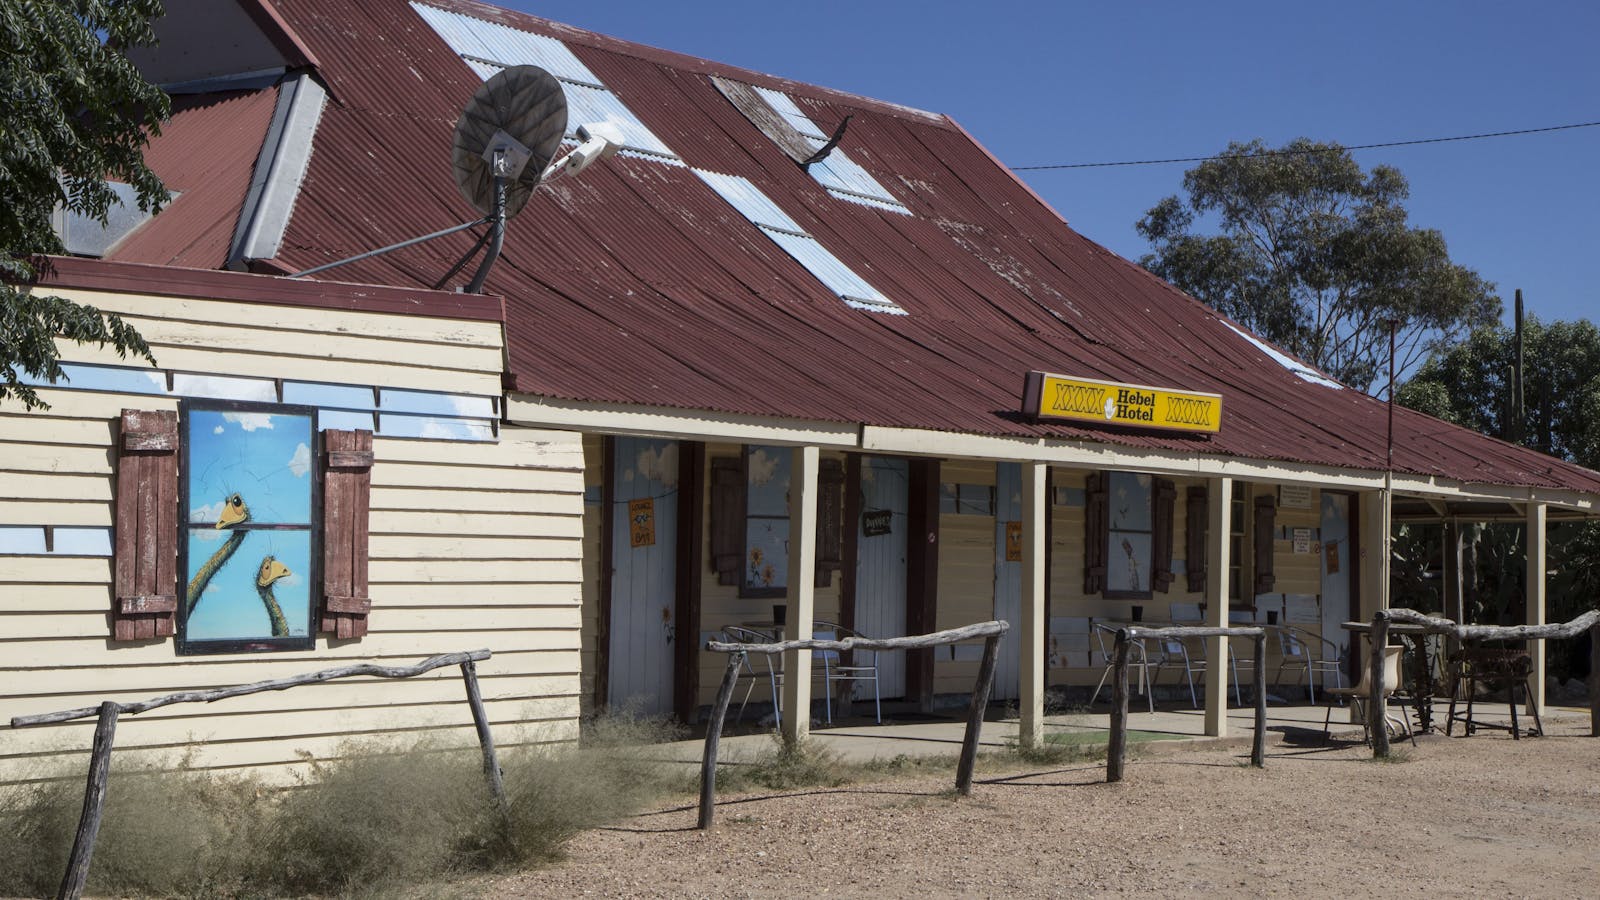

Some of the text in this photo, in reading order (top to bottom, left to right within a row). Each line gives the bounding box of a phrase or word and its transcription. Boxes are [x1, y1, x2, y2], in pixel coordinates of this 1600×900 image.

[1053, 383, 1105, 414] XXXX
[1117, 389, 1155, 407] Hebel
[1116, 405, 1153, 421] Hotel
[1165, 396, 1211, 426] XXXX
